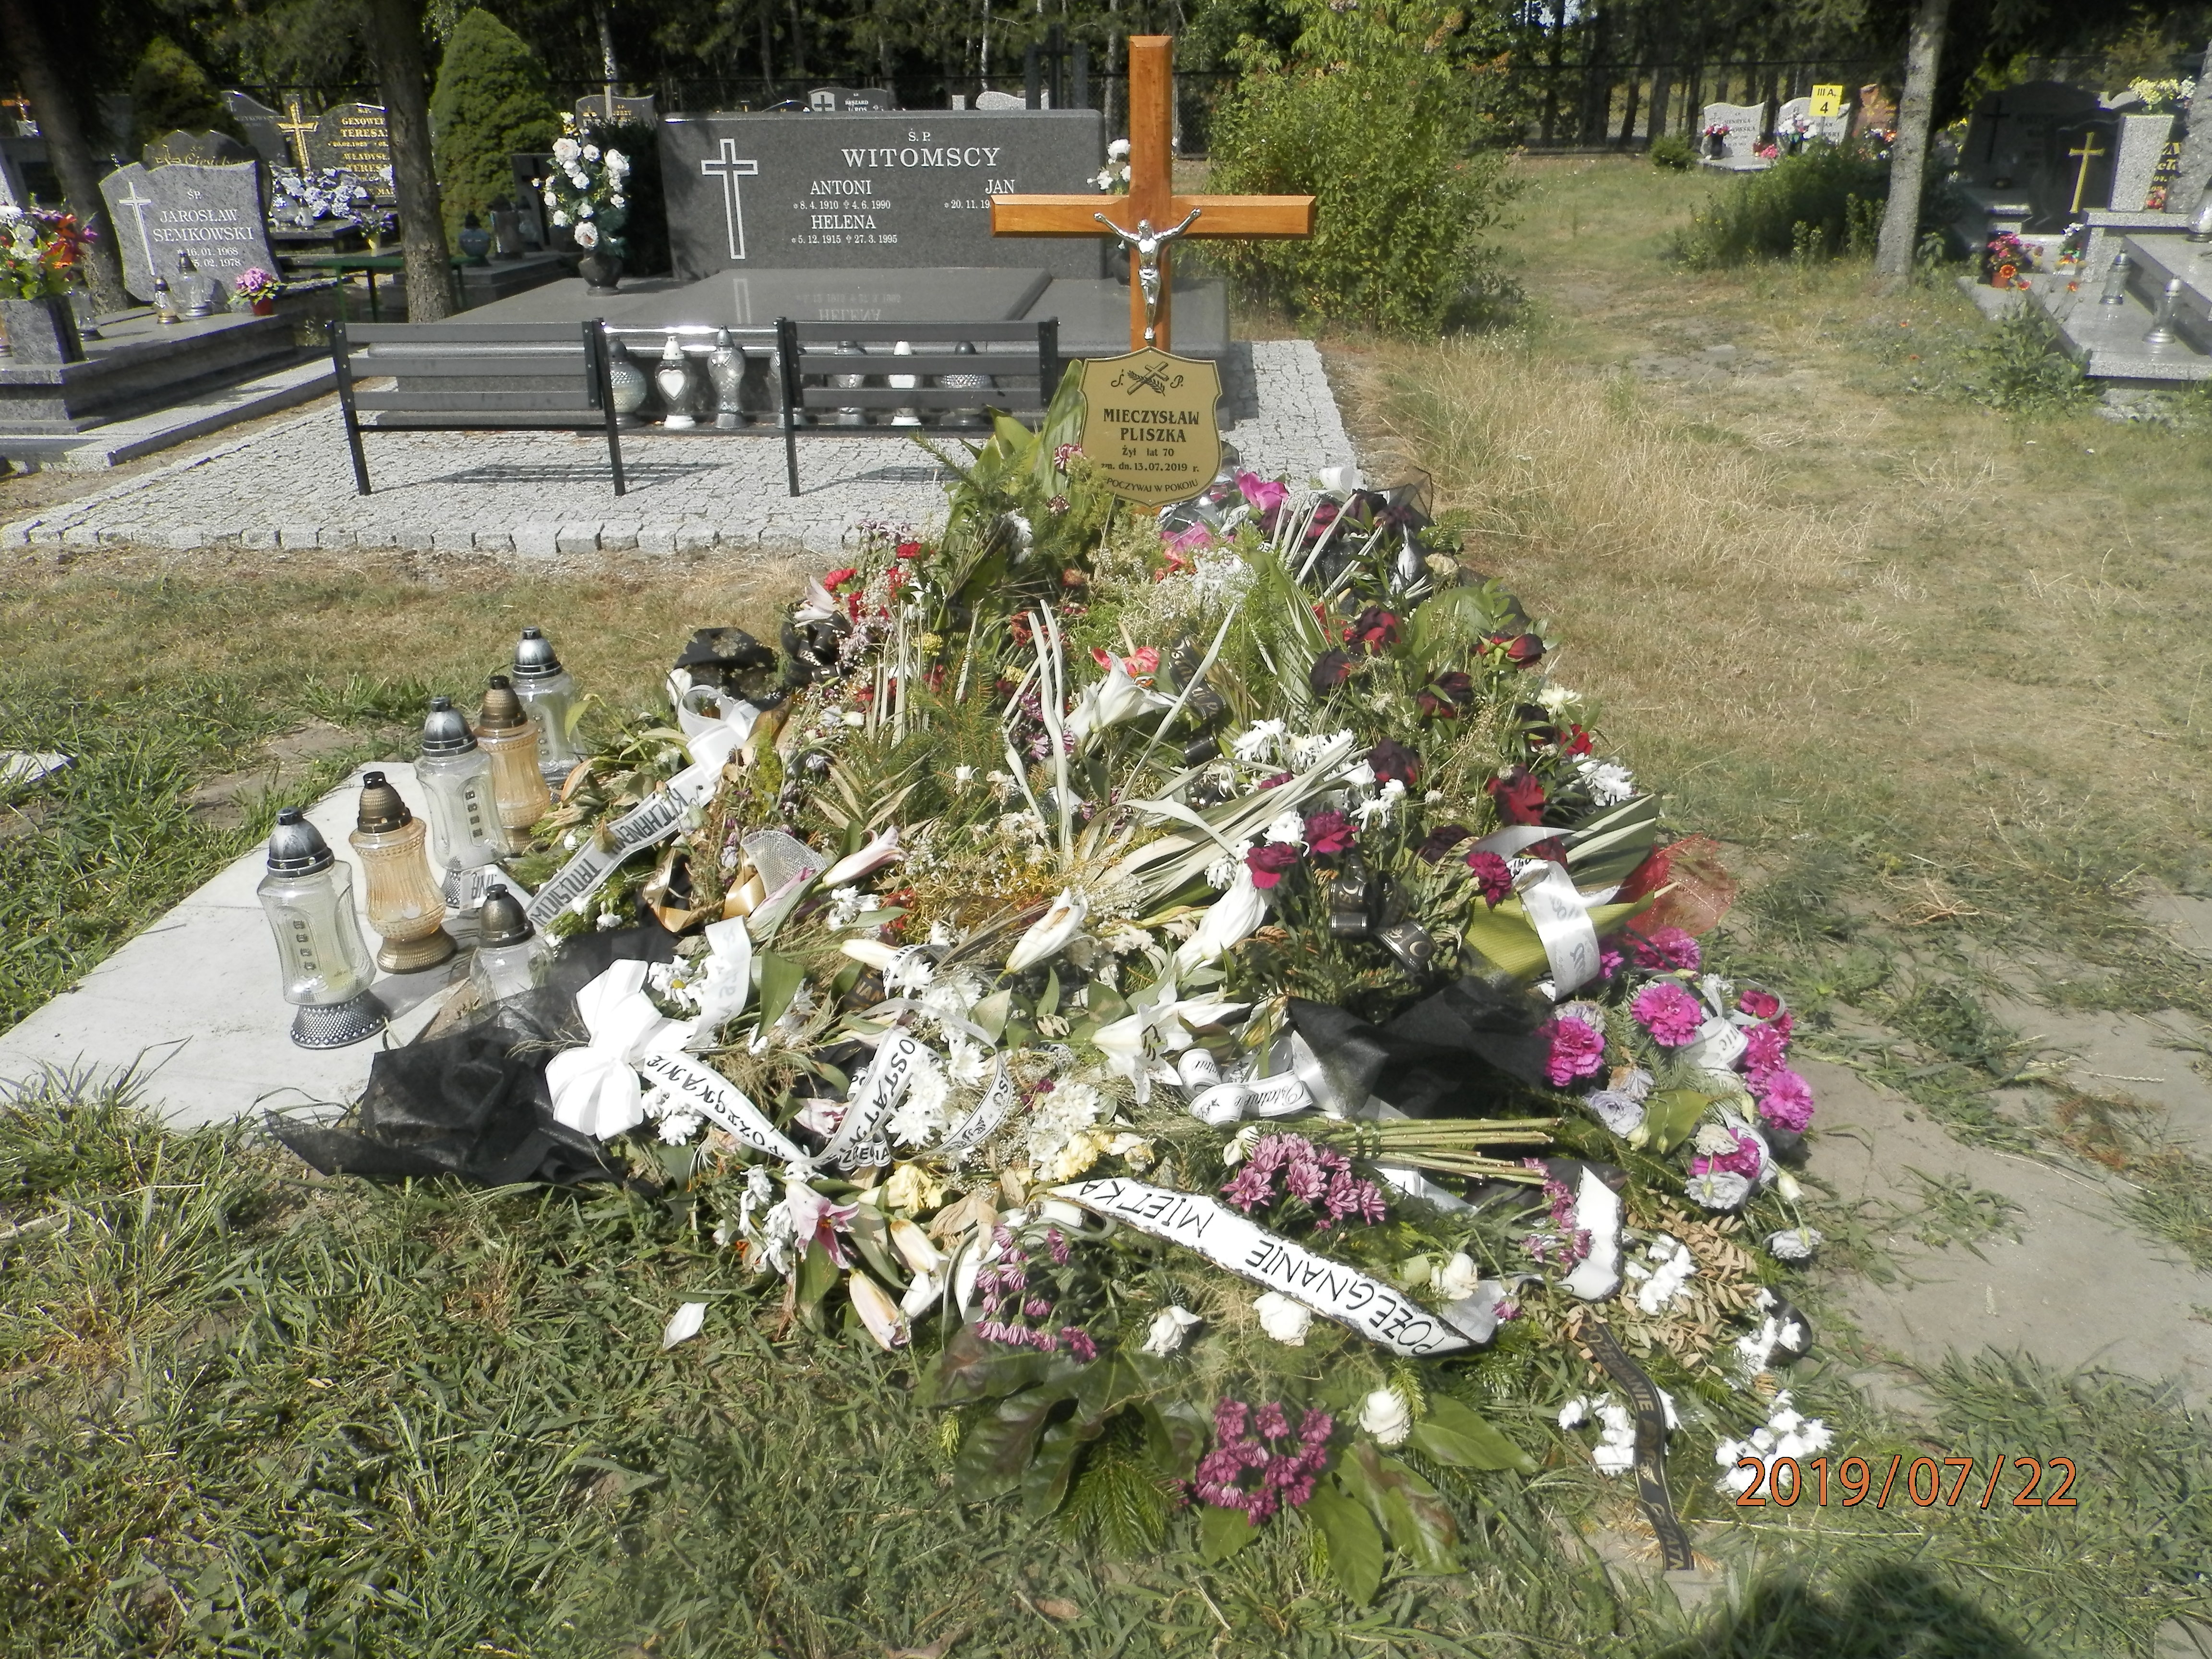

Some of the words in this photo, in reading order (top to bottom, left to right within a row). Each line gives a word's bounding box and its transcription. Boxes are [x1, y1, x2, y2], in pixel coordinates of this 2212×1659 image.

[1820, 101, 1828, 114] 4
[922, 132, 931, 142] P.
[841, 147, 1000, 168] WITOMSCY
[810, 180, 872, 196] ANTONI
[985, 179, 1016, 194] JAN
[799, 200, 807, 210] 8.
[810, 200, 817, 210] 4.
[819, 200, 839, 210] 1910
[852, 200, 859, 210] 4.
[861, 200, 869, 210] 6.
[871, 200, 891, 210] 1990
[950, 200, 963, 210] 20.
[966, 200, 977, 210] 11.
[159, 209, 238, 223] JAROSŁAW
[810, 215, 877, 230] HELENA
[152, 227, 254, 242] SEMKOWSKI
[797, 235, 805, 244] 5.
[808, 235, 819, 244] 12.
[822, 234, 842, 244] 1915
[854, 235, 866, 244] 27.
[868, 234, 877, 244] 3.
[878, 234, 898, 244] 1995
[186, 248, 200, 256] 16.
[201, 248, 215, 256] 01.
[217, 246, 239, 256] 1968
[219, 258, 241, 267] 1978
[1103, 408, 1200, 425] MIECZYSŁAW
[1120, 427, 1187, 443] PLISZKA
[1121, 445, 1136, 457] Żył
[1146, 448, 1158, 457] lat
[1162, 448, 1175, 457] 70
[1118, 462, 1132, 470] dn.
[1134, 462, 1188, 471] 13.07.2019
[1154, 485, 1162, 493] W
[1165, 479, 1199, 493] POKOJU
[646, 1054, 786, 1158] POŻEGNANIE
[1079, 1180, 1214, 1239] MIETKA
[1245, 1238, 1445, 1356] POŻEGNANIE
[1586, 1321, 1656, 1413] POŻEGNANIE
